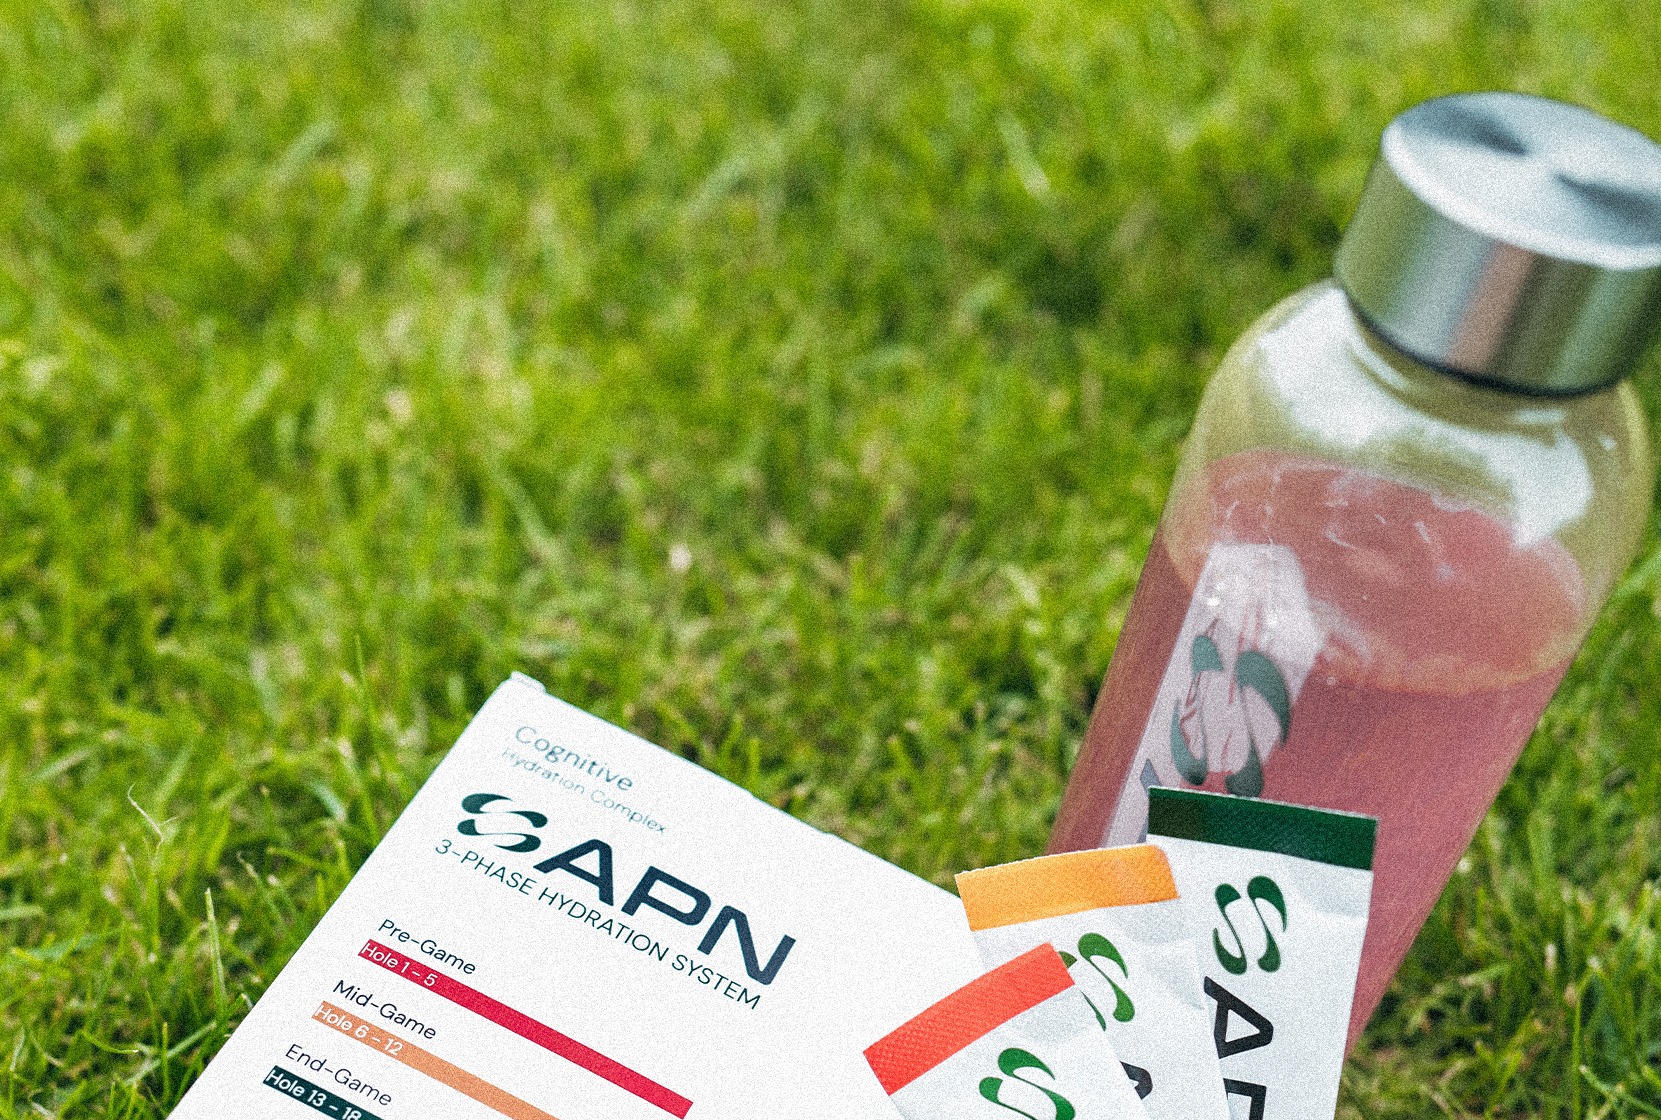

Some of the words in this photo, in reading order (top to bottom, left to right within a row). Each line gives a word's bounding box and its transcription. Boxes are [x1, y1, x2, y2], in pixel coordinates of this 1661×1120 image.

[515, 725, 633, 791] Cognitive
[500, 748, 585, 795] Hydration
[590, 788, 667, 835] Complex
[378, 919, 476, 975] Pre-Game
[435, 839, 538, 895] 3-PHASE
[538, 886, 669, 961] HYDRATION
[671, 954, 761, 1010] SYSTEM
[361, 942, 398, 968] Hole
[400, 961, 410, 973] 1
[424, 973, 438, 987] 5
[315, 1005, 352, 1031] Hole
[355, 1025, 369, 1038] 6
[385, 1038, 403, 1056] 12
[333, 979, 436, 1040] Mid-Game
[266, 1070, 305, 1097] Hole
[307, 1089, 327, 1108] 13
[285, 1043, 392, 1106] End-Game
